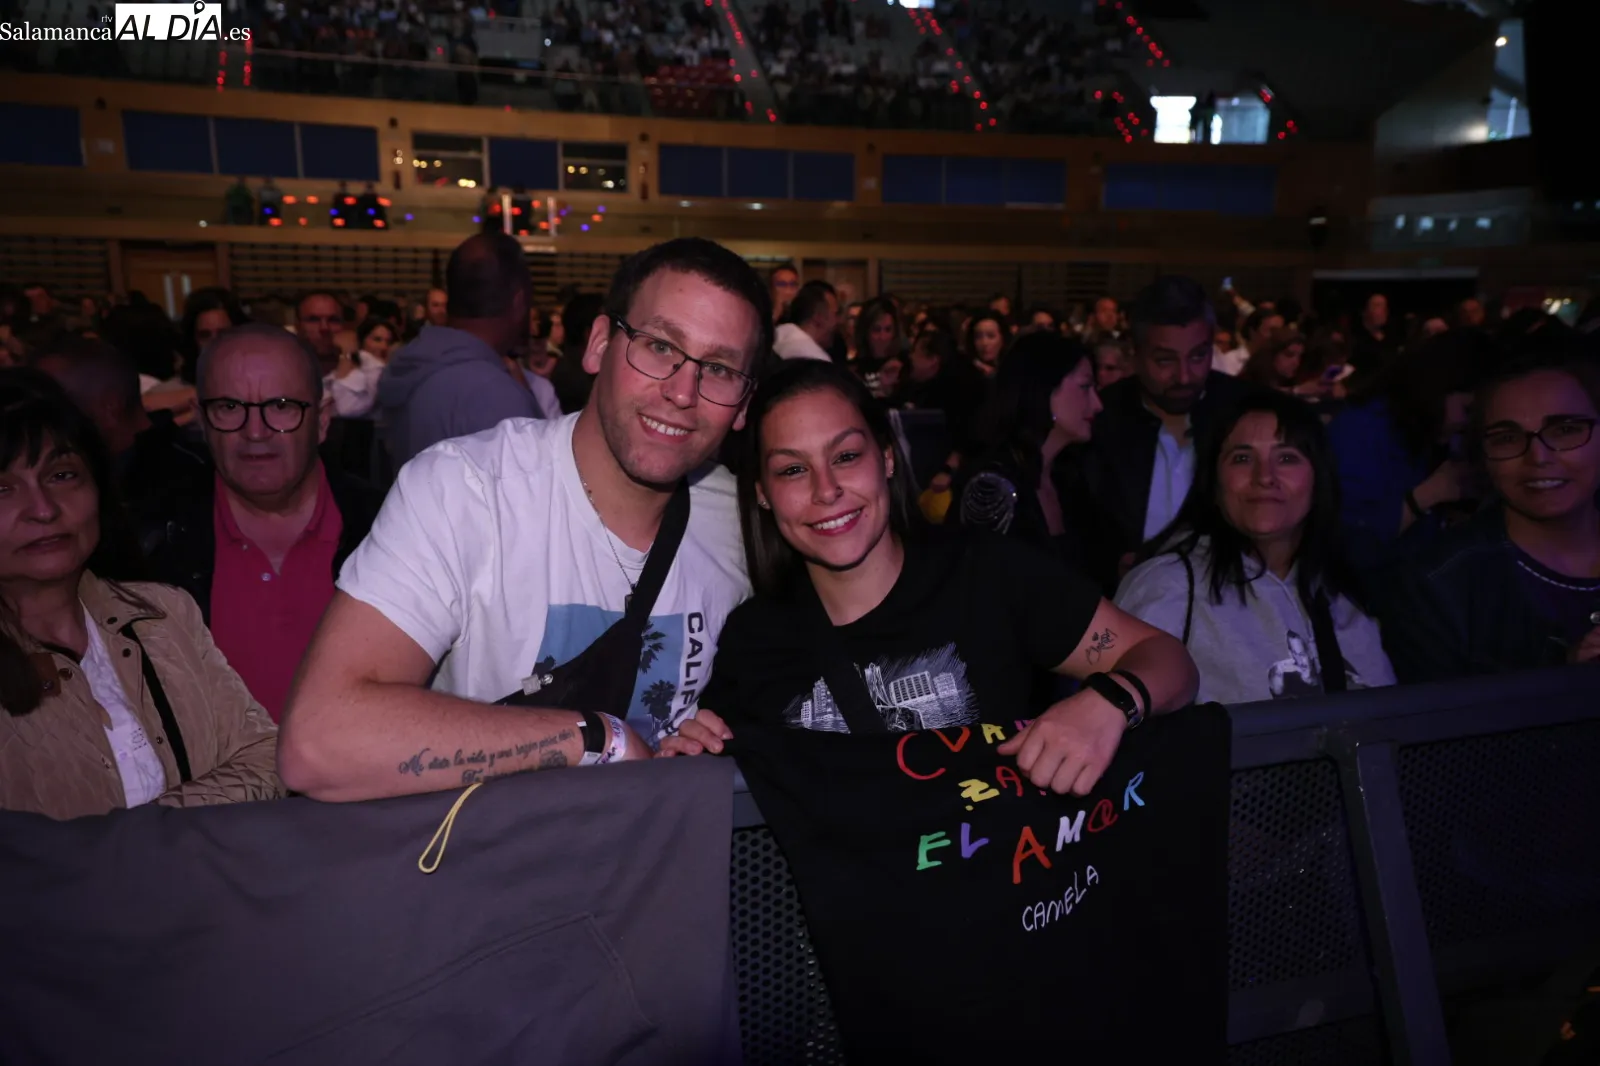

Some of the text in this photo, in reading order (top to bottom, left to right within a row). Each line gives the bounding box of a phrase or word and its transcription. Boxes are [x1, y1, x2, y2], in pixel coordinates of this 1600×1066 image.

[915, 771, 1146, 885] EL AMOR
[1021, 864, 1100, 932] CAMELA
